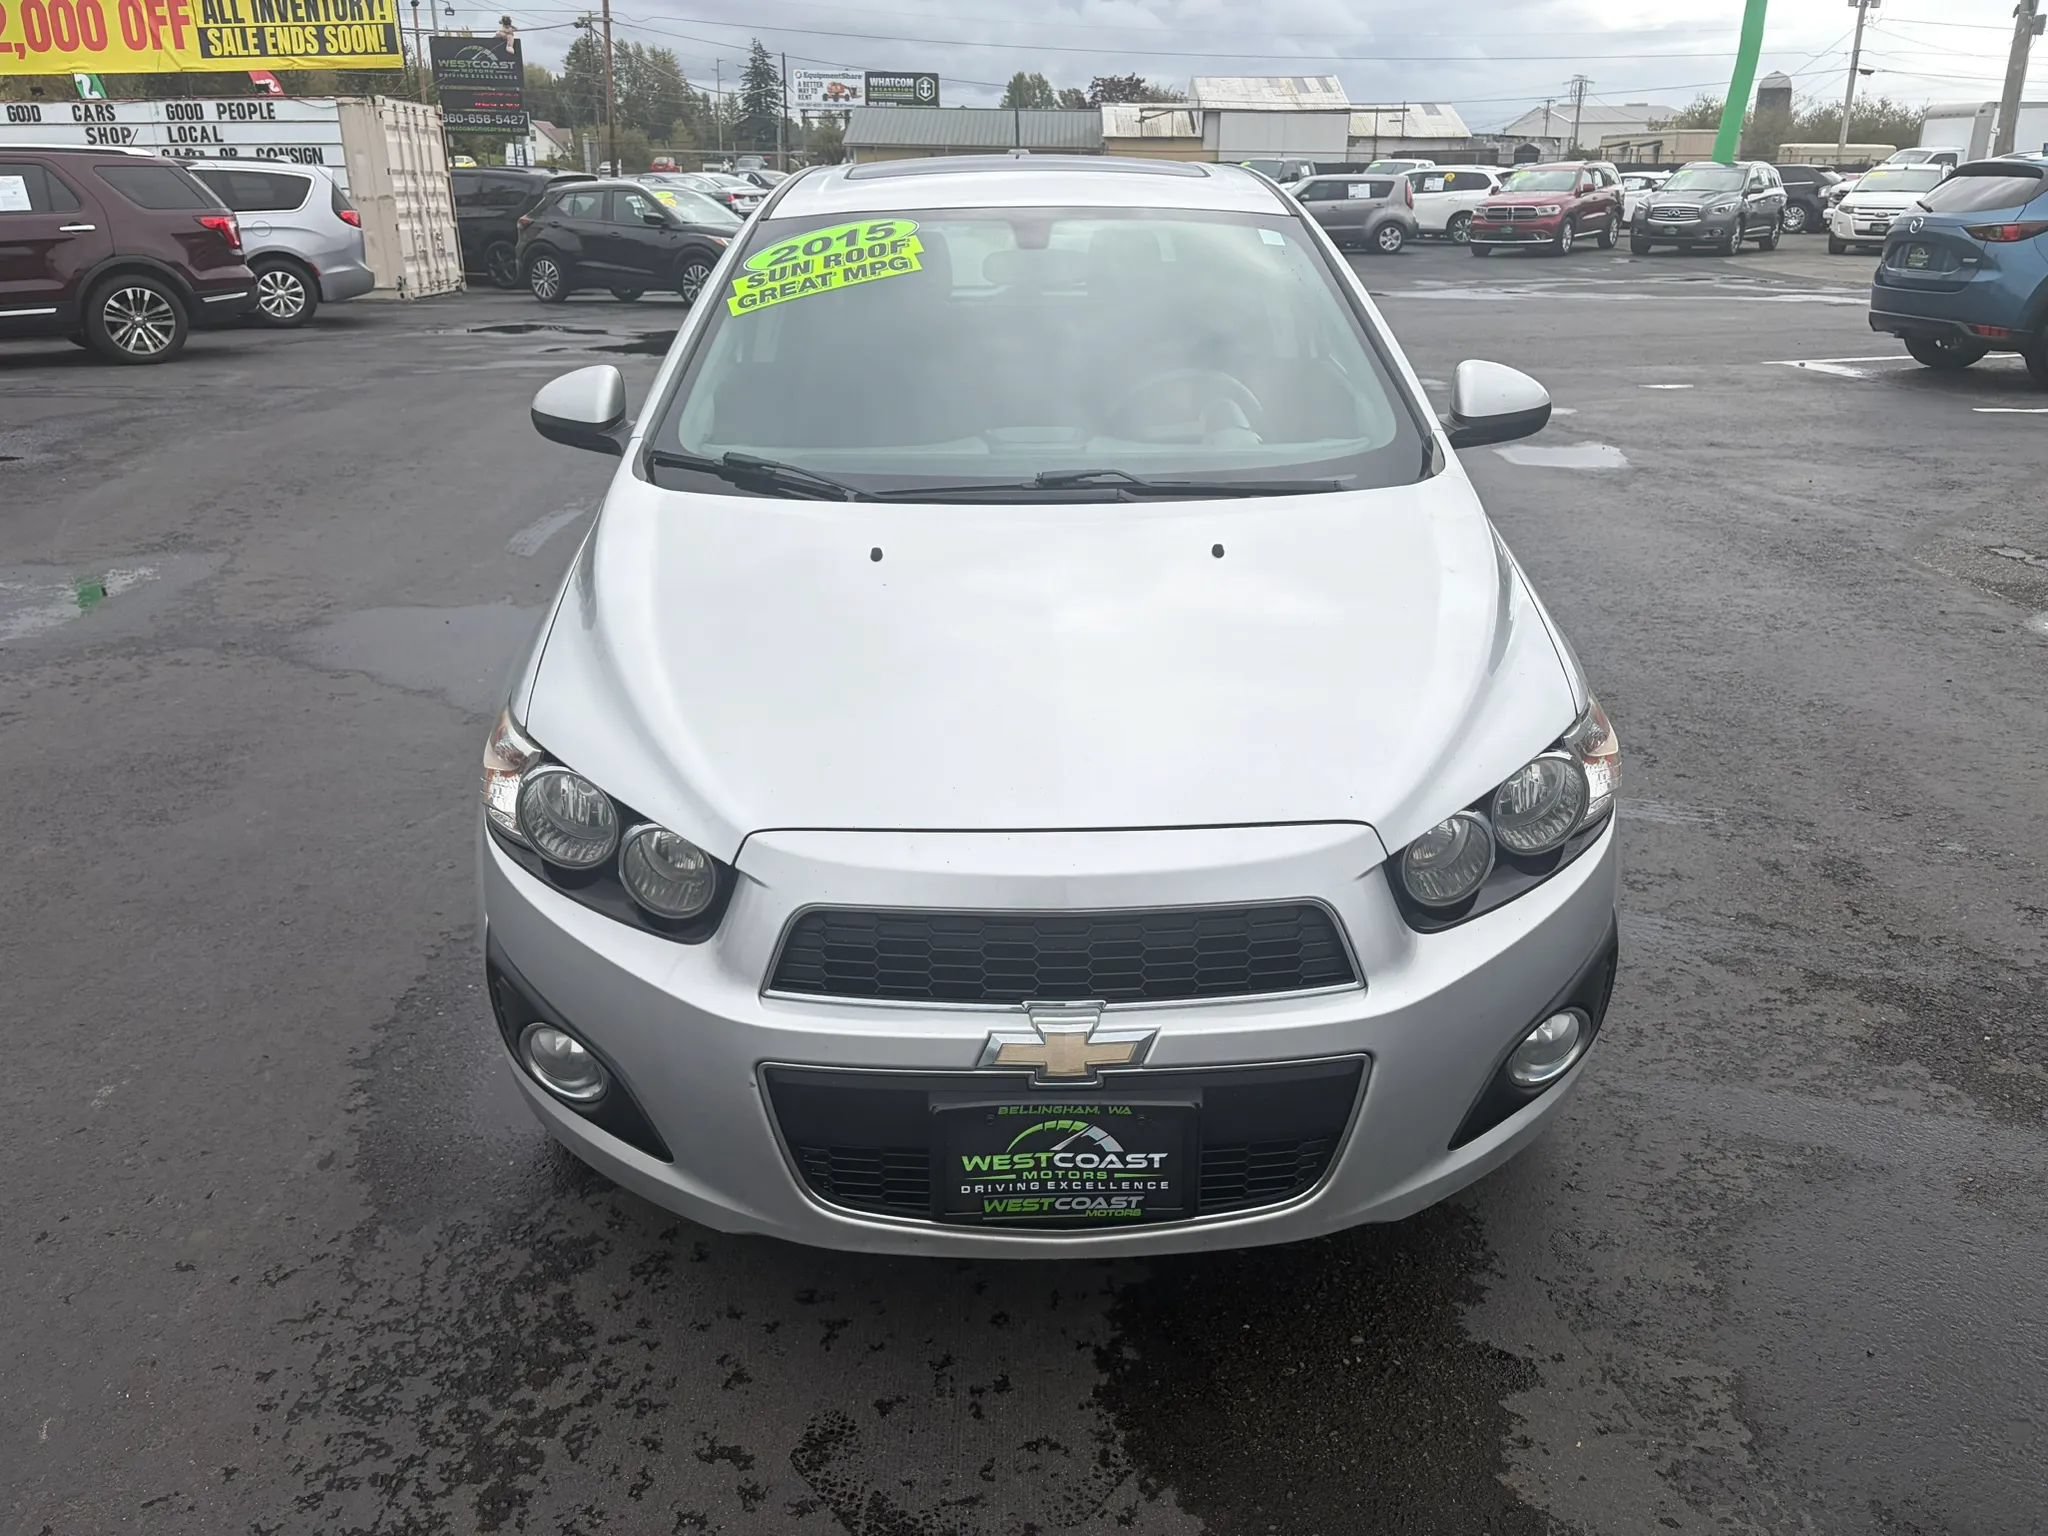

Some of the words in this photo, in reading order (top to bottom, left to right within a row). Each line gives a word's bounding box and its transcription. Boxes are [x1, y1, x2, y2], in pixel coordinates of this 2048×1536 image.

[202, 0, 245, 24] ALL
[250, 0, 386, 23] INVENTORY!
[118, 0, 190, 51] OFF
[207, 27, 260, 56] SALE
[264, 26, 319, 55] ENDS
[323, 24, 387, 54] SOON!
[437, 59, 516, 69] WESTCOAST
[869, 77, 914, 87] WHATCOM
[71, 104, 116, 121] CARS
[165, 103, 204, 121] GOOD
[216, 102, 276, 120] PEOPLE
[166, 125, 224, 143] LOCAL
[256, 147, 324, 164] CONSIGN
[766, 221, 896, 267] 2015
[746, 260, 815, 289] SUN
[823, 239, 910, 269] ROOF
[737, 272, 836, 309] GREAT
[843, 256, 912, 283] MPG
[1108, 1106, 1133, 1115] WA
[961, 1152, 1169, 1172] WESTCOAST
[1022, 1170, 1108, 1180] MOTORS
[961, 1182, 1040, 1193] DRIVING
[1047, 1181, 1169, 1190] EXCELLENCE
[983, 1195, 1145, 1214] WESTCOAST
[1085, 1208, 1142, 1217] MOTORS
